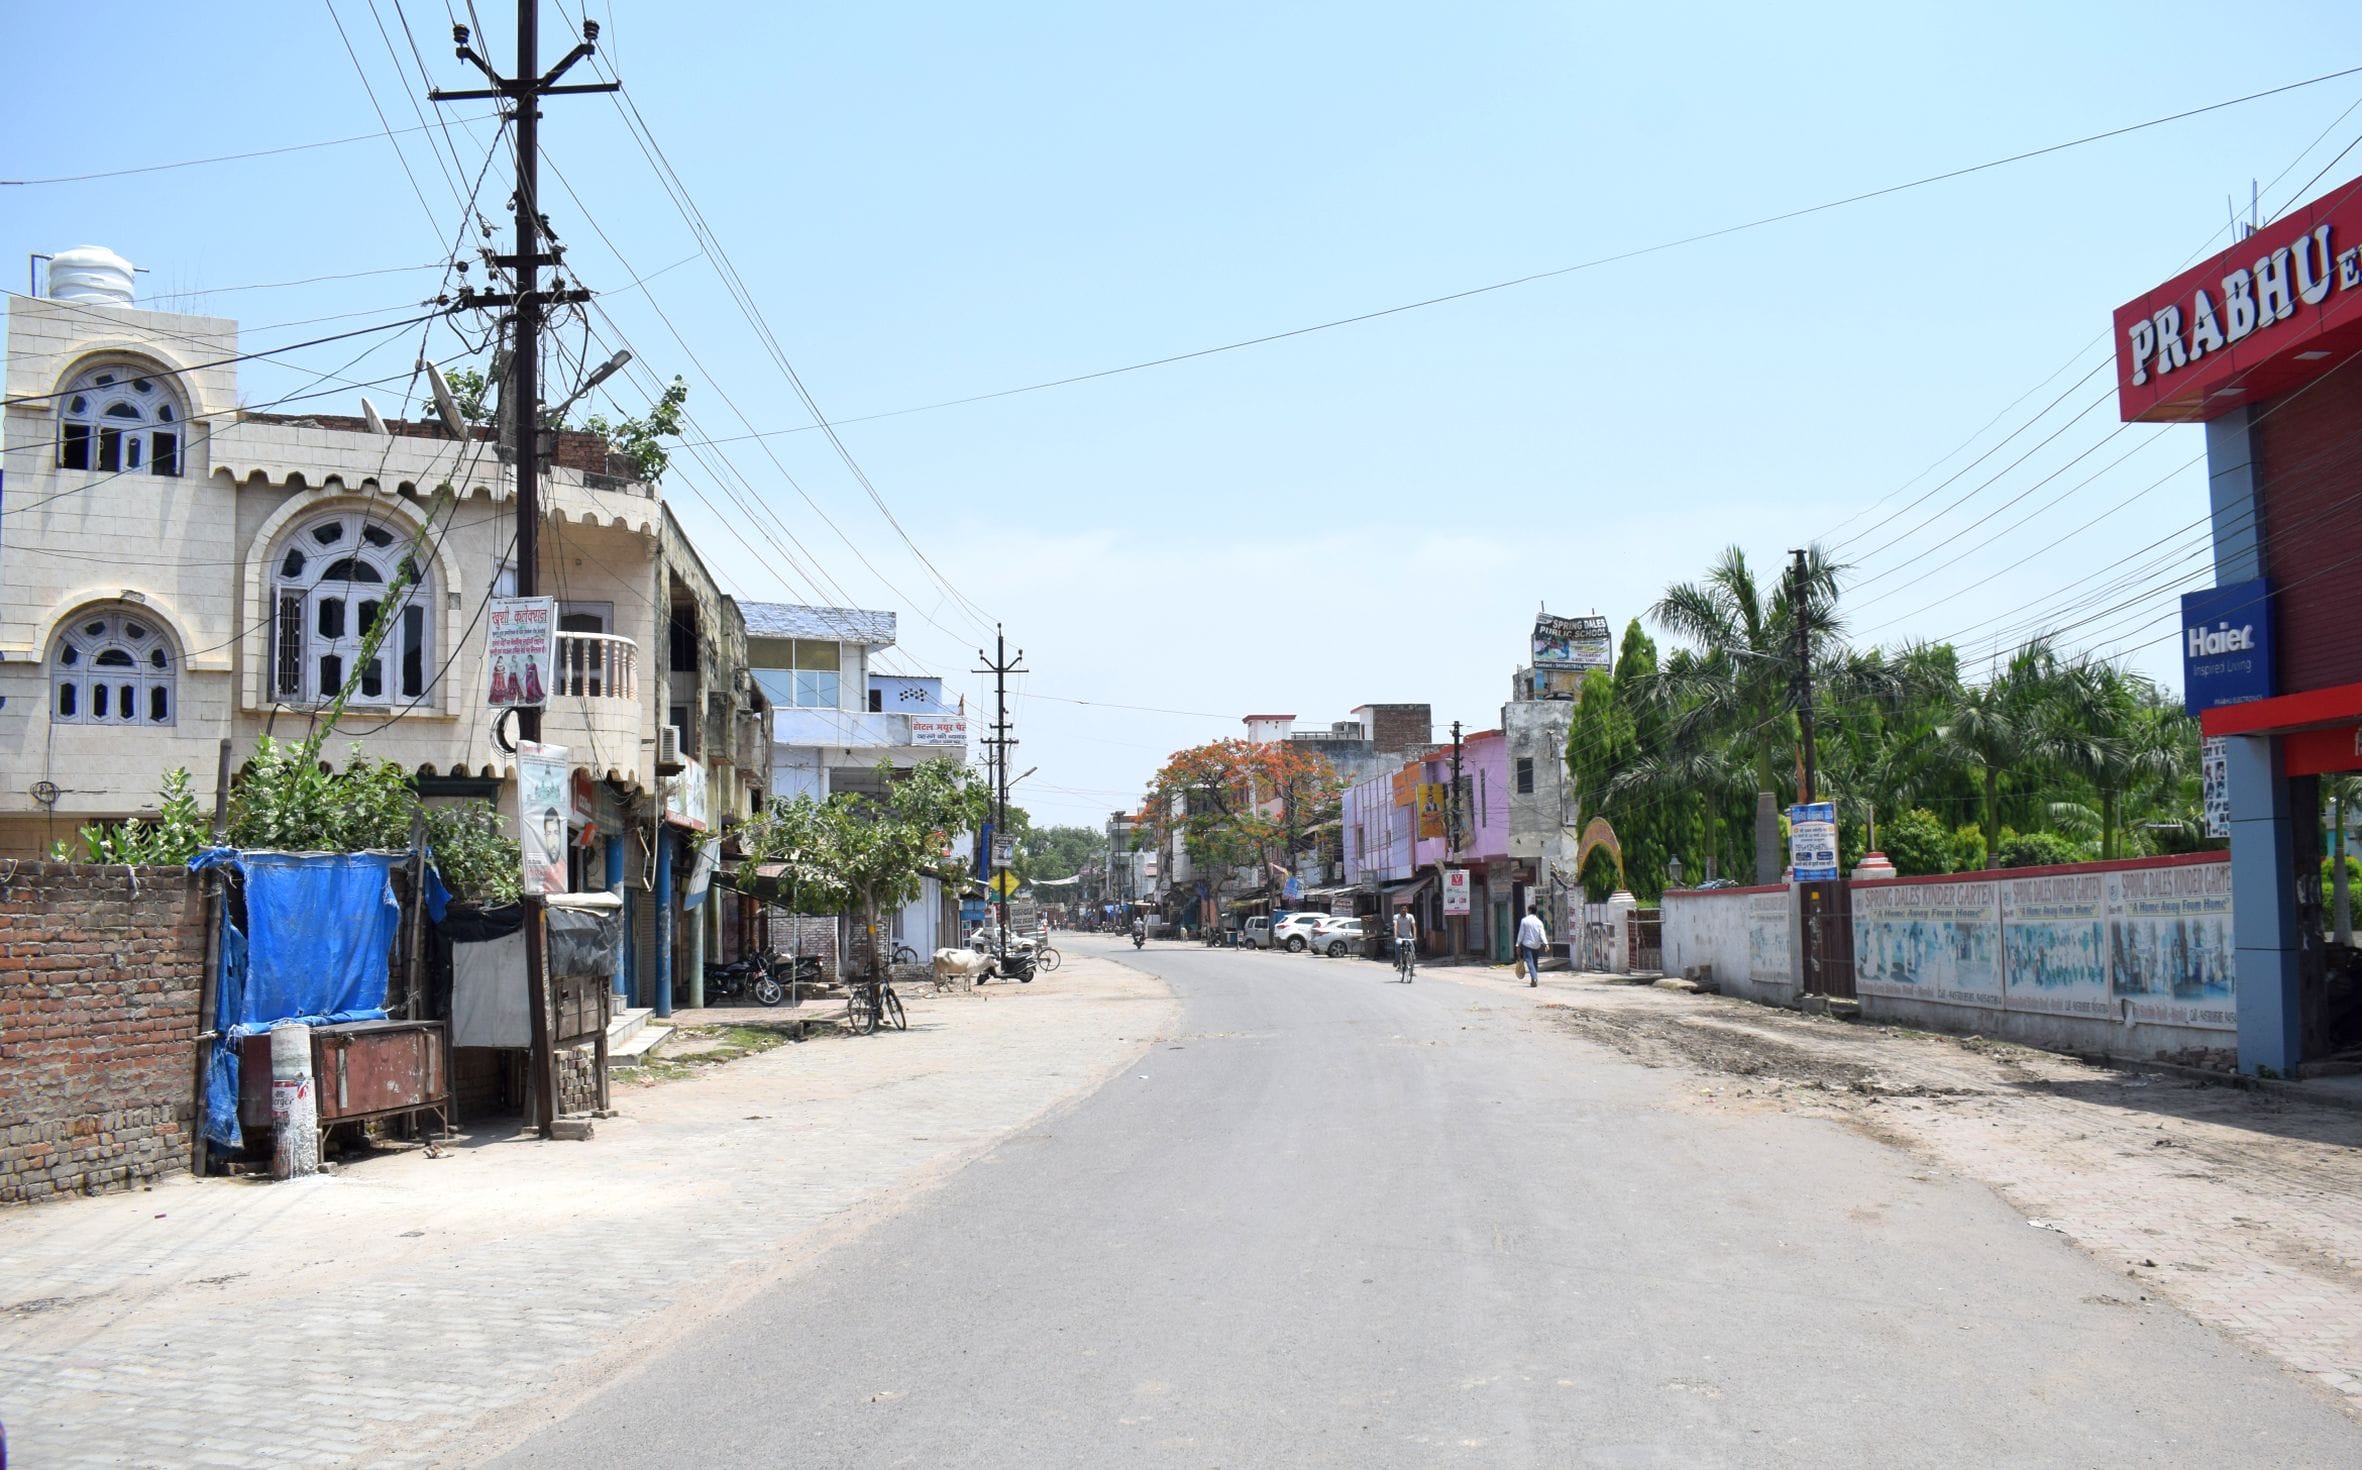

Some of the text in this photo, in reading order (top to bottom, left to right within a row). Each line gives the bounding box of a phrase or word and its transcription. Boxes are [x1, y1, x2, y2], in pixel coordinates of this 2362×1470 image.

[2129, 223, 2362, 387] PRABHU E
[1540, 626, 1608, 639] PUBLIC SCHOOL
[1552, 619, 1582, 631] SPRING
[1583, 619, 1606, 630] DALES
[2188, 622, 2255, 658] Haier
[2193, 659, 2253, 678] Inspired Living
[913, 722, 933, 731] होटल
[2013, 876, 2102, 904] SPRING DALES KINDER GARTEN
[2121, 865, 2232, 899] SPRING DALES KINDER GARTE
[1865, 883, 1995, 908] SPRING DALES KINDER GARTEN
[1884, 909, 1905, 918] Home
[1908, 908, 1929, 919] Away
[1931, 908, 1953, 917] From
[2026, 906, 2042, 915] Home
[2043, 906, 2058, 918] Away
[2059, 905, 2074, 914] From
[2140, 901, 2159, 911] Home
[2161, 900, 2180, 915] Away
[2182, 899, 2202, 911] From
